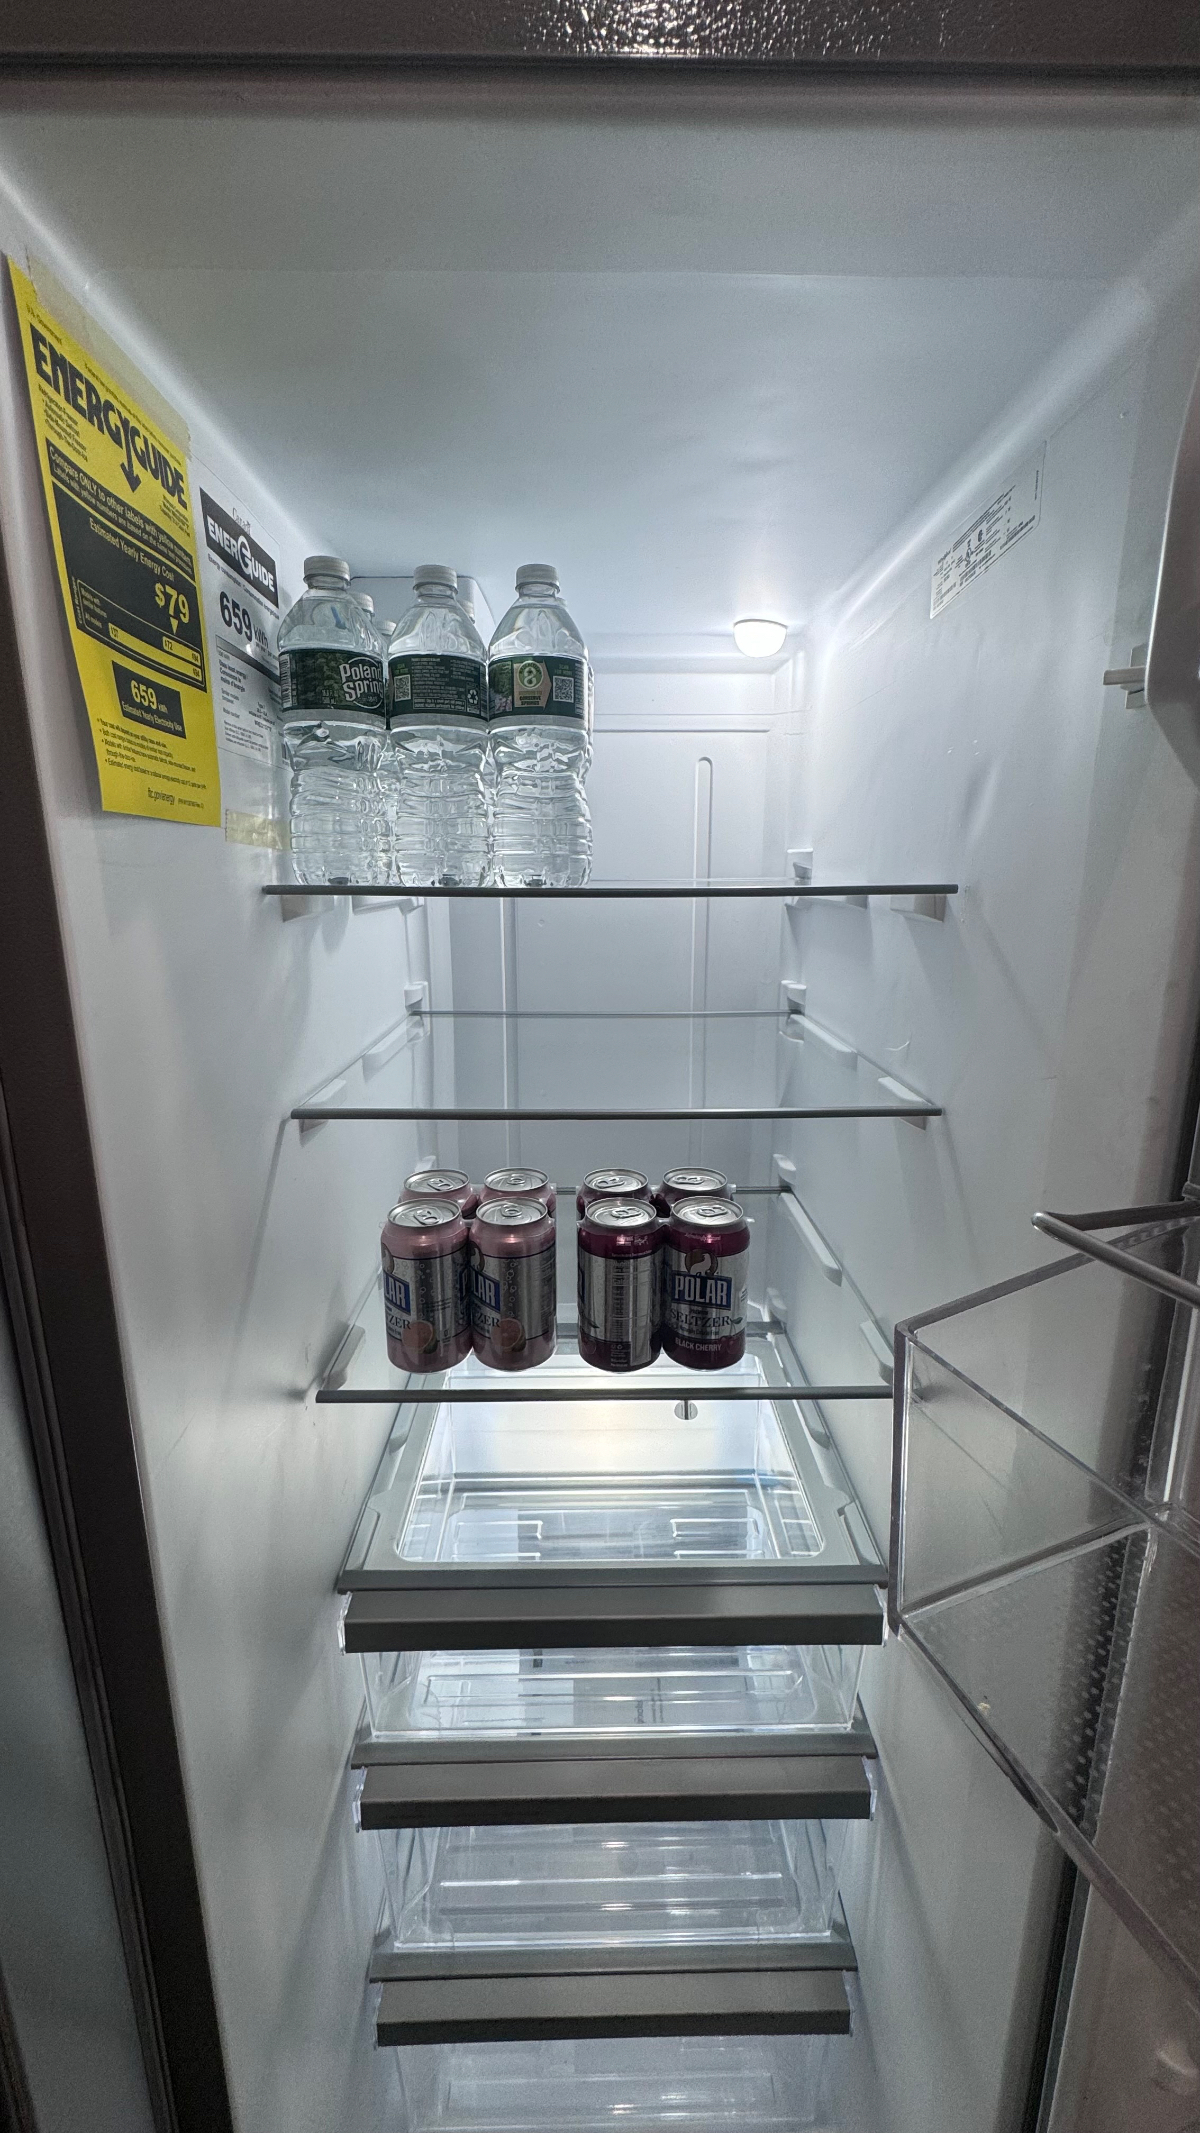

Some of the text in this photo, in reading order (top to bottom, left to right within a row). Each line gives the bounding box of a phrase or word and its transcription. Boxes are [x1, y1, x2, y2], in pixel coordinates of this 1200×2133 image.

[30, 322, 188, 510] ENERGYGUIDE
[49, 445, 78, 482] Compare
[79, 471, 97, 497] ONLY
[97, 485, 106, 503] to
[106, 490, 123, 516] other
[124, 503, 143, 529] labels
[89, 516, 174, 583] Estimated Yearly Energy Cost
[206, 515, 275, 593] ENERGUIDE
[154, 582, 189, 624] $79
[220, 591, 252, 642] 659
[339, 663, 382, 683] Poland
[343, 679, 383, 701] Spring
[130, 679, 158, 710] 659
[384, 1272, 406, 1309] LAR
[473, 1270, 496, 1307] LAR
[674, 1275, 728, 1306] POLAR
[670, 1308, 731, 1329] SELTZER
[675, 1337, 722, 1352] BLACK CHERRY
